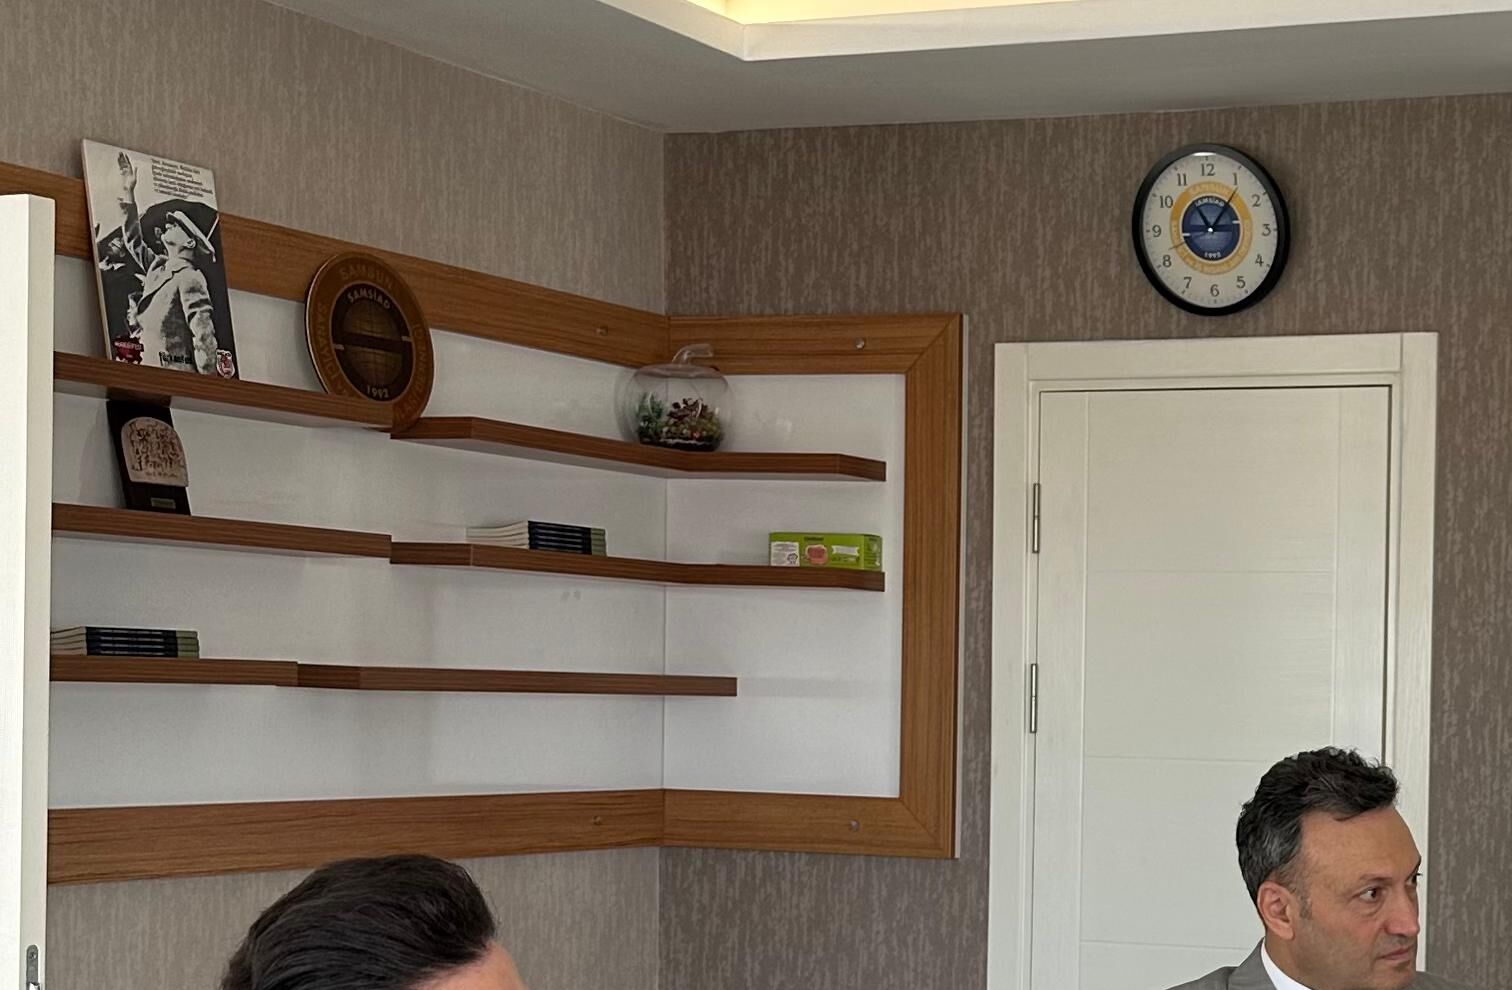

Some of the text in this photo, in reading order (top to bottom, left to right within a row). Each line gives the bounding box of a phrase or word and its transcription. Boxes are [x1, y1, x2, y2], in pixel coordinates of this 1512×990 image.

[1201, 163, 1215, 176] 12
[1177, 173, 1187, 186] 11
[1233, 173, 1238, 185] 1
[1159, 195, 1173, 208] 10
[1252, 194, 1261, 207] 2
[1152, 225, 1161, 237] 9
[1262, 224, 1271, 235] 3
[1162, 255, 1172, 268] 8
[1255, 254, 1264, 266] 4
[1184, 277, 1192, 289] 7
[1237, 276, 1245, 289] 5
[1210, 284, 1219, 296] 6
